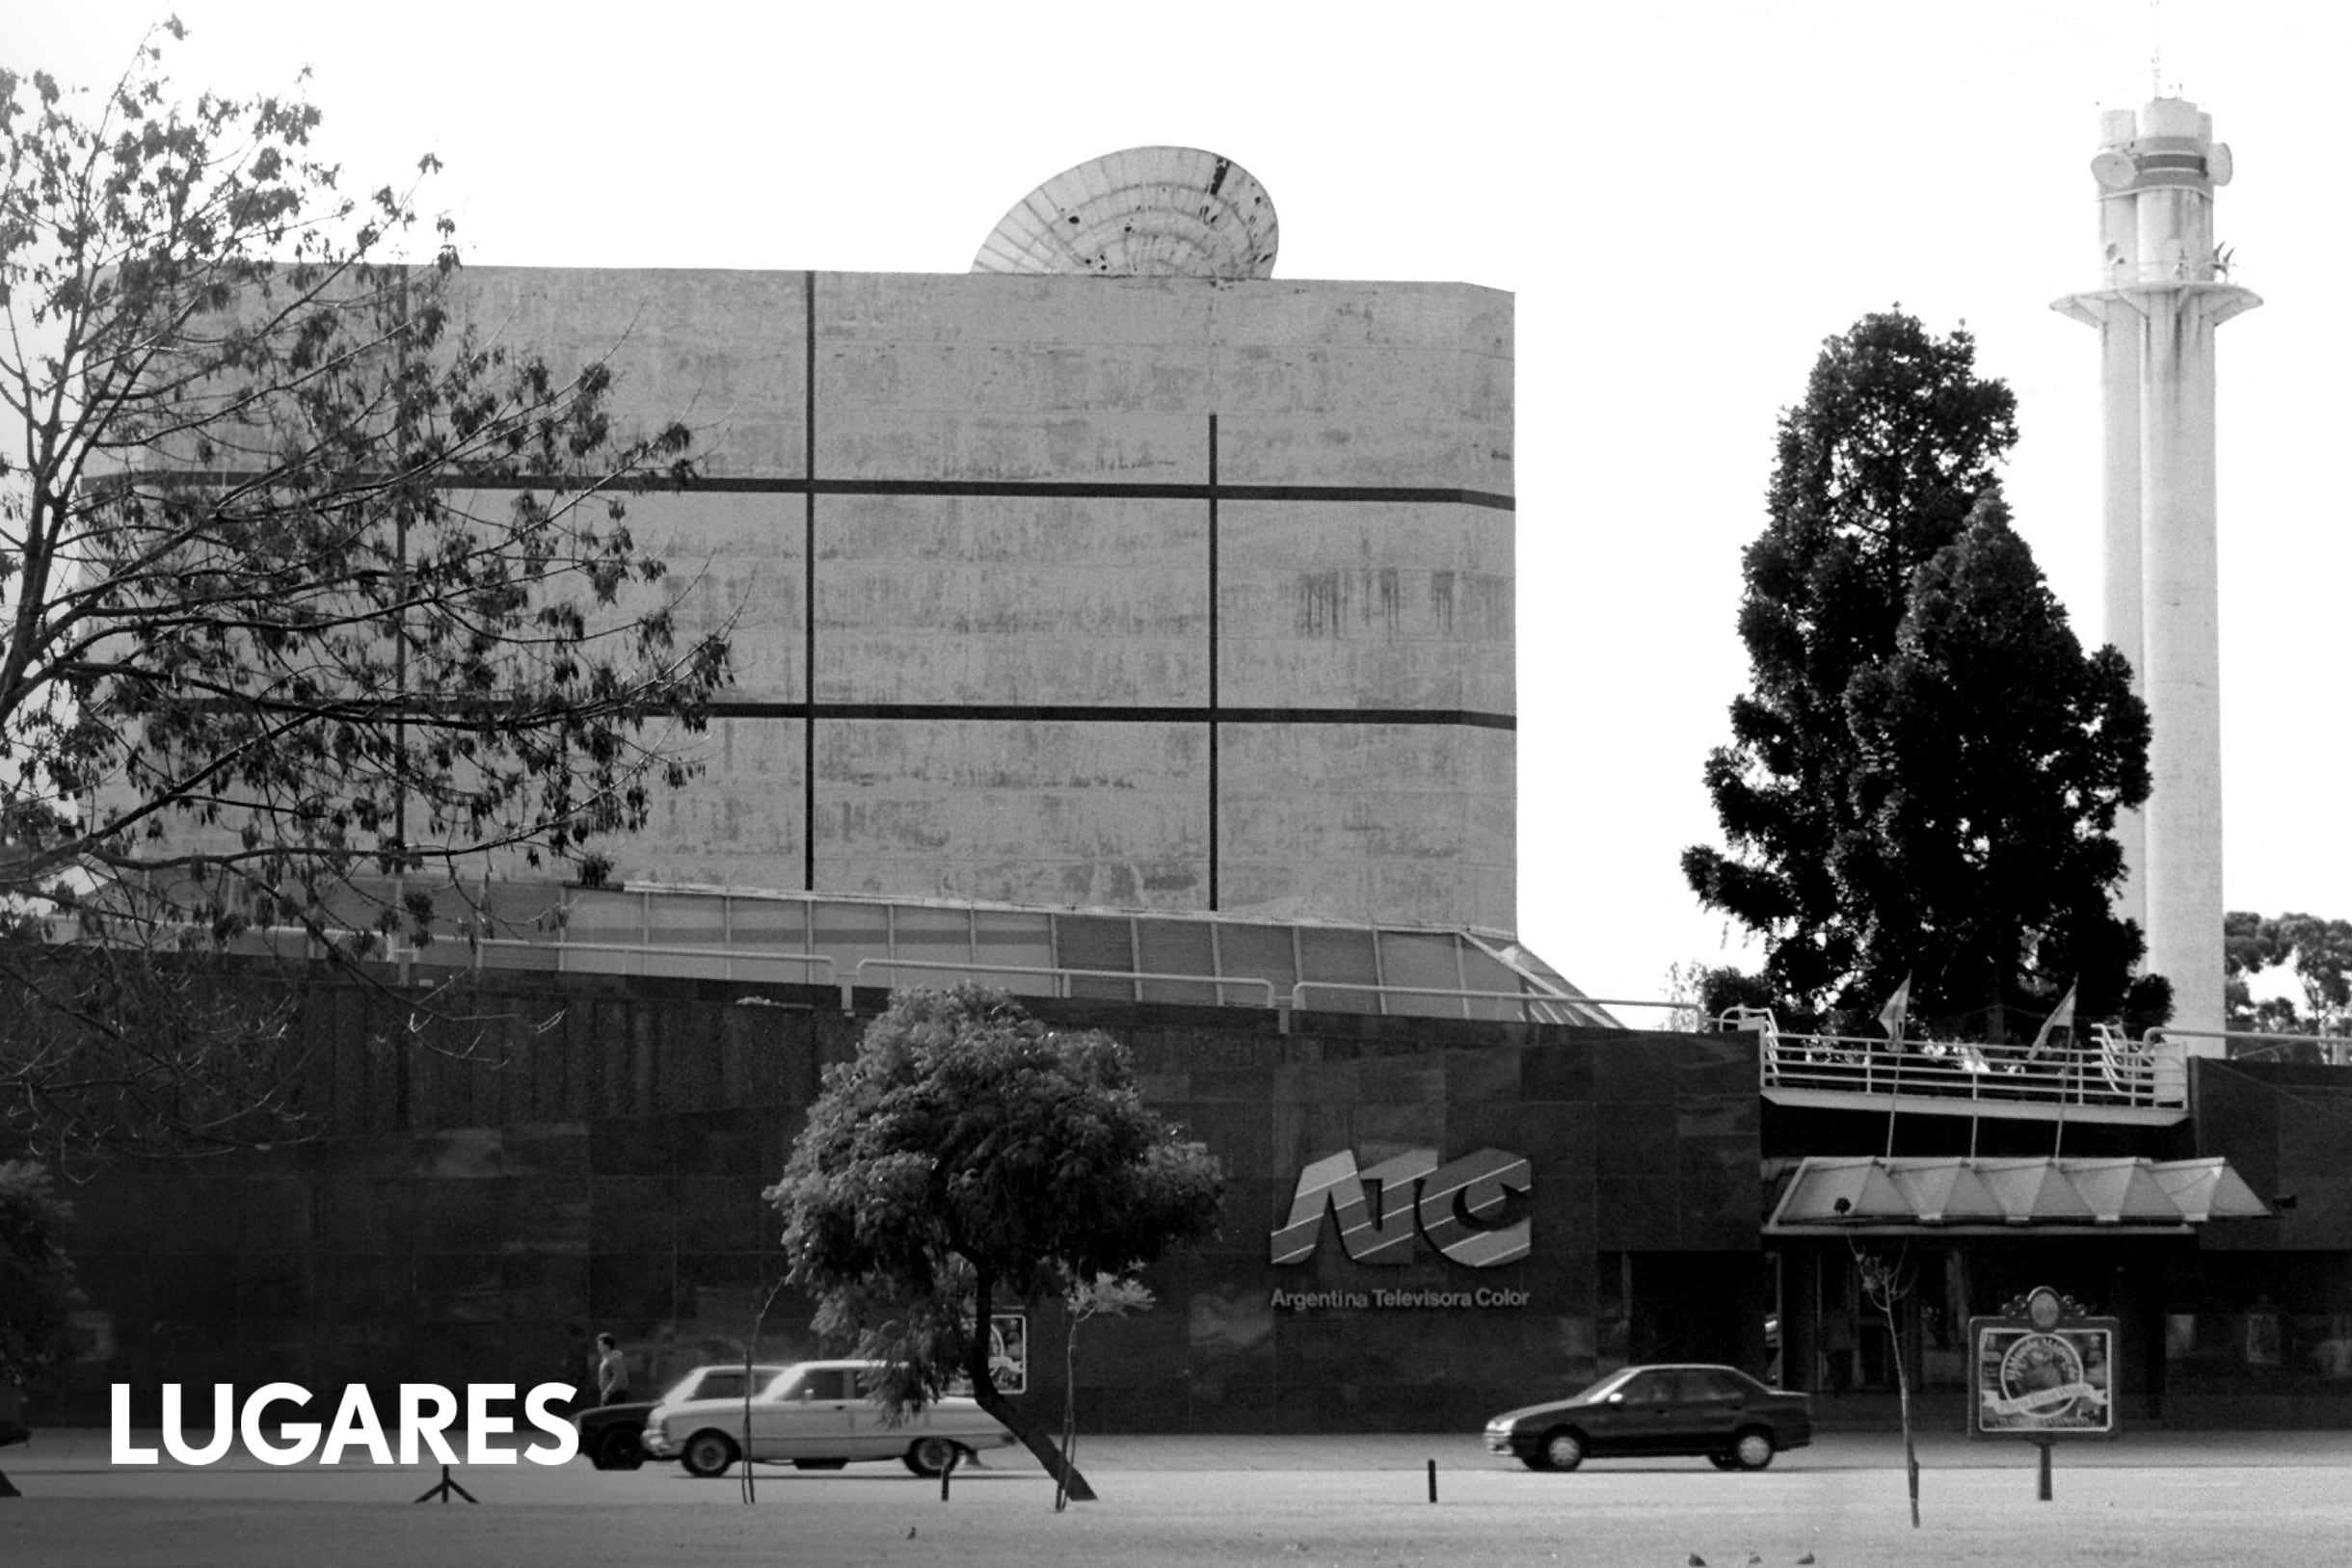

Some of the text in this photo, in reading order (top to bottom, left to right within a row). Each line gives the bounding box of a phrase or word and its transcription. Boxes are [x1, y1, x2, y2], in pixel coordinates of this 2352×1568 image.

[1270, 1288, 1530, 1311] Argentina Televisora Color
